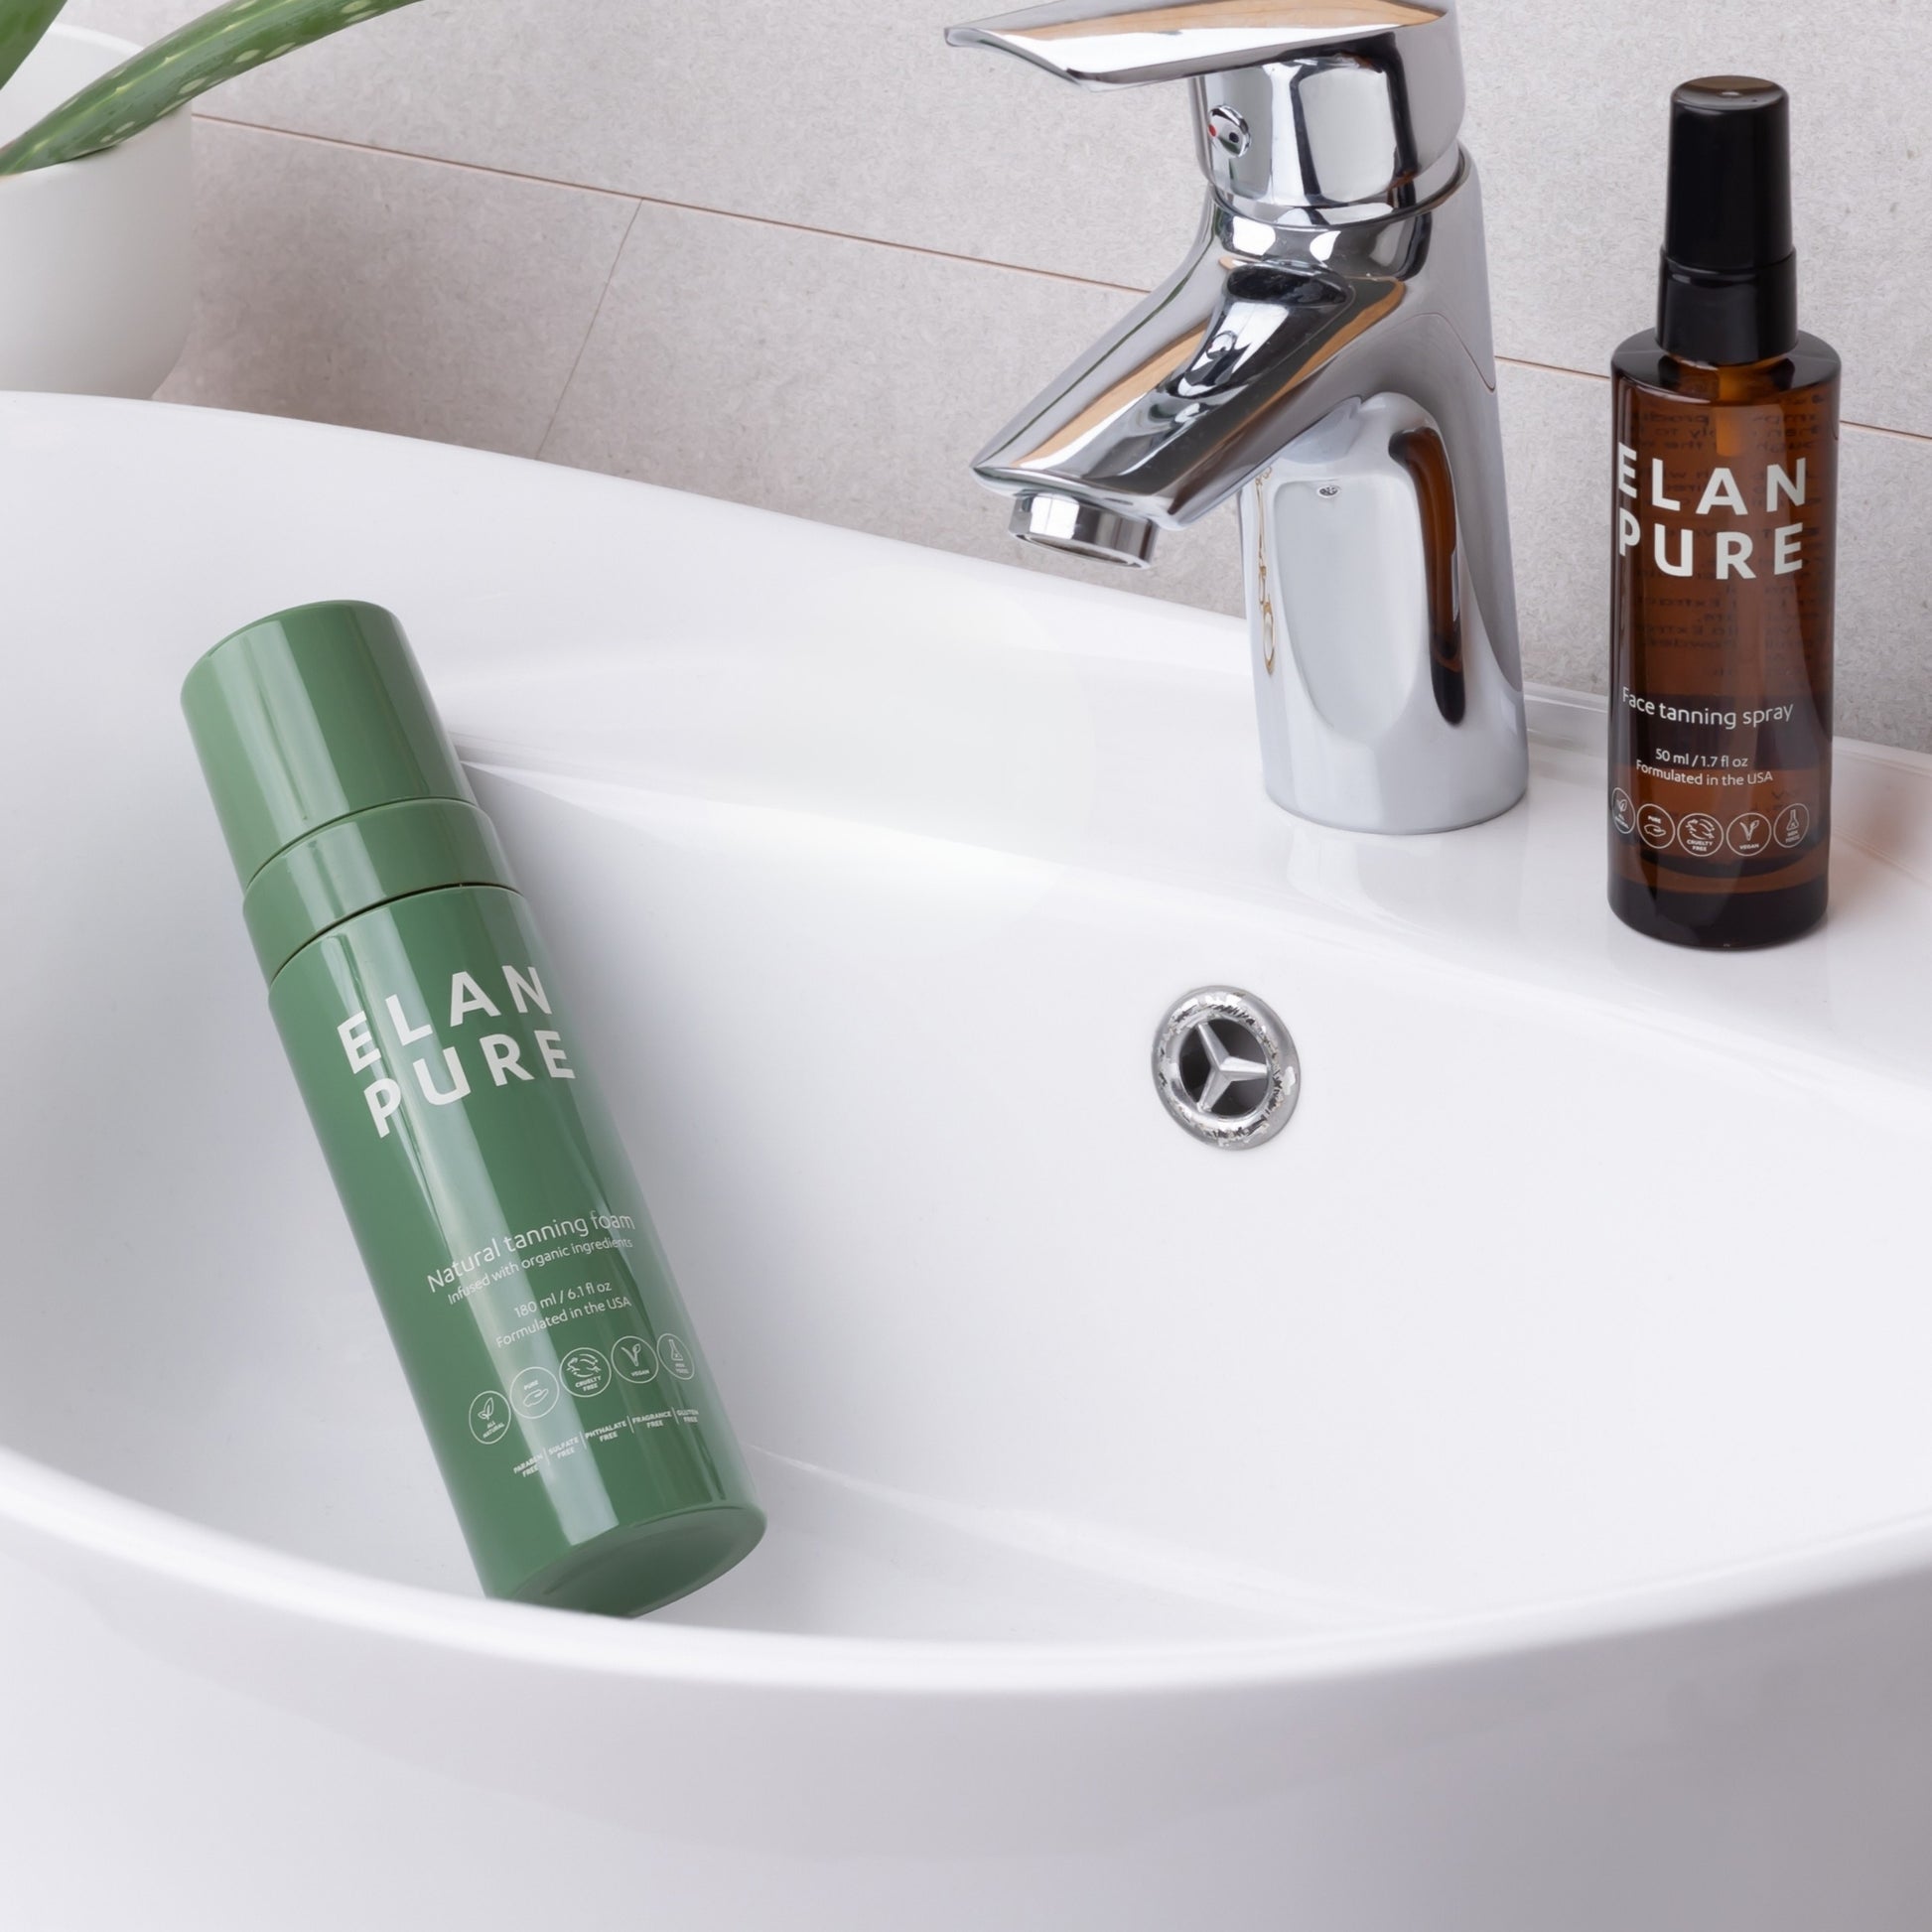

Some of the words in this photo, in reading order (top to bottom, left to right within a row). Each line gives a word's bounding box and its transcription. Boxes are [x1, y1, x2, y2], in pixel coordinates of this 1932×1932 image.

[1618, 441, 1806, 515] ELAN
[1619, 507, 1803, 580] PURE
[1622, 687, 1654, 715] Face
[1659, 703, 1736, 730] tanning
[1742, 703, 1794, 727] spray
[1636, 759, 1703, 785] Formulated
[1707, 774, 1718, 785] in
[1723, 774, 1743, 785] the
[1747, 770, 1773, 784] USA
[1656, 749, 1670, 761] 50
[1673, 753, 1689, 764] ml
[1701, 756, 1718, 767] 1.7
[1721, 756, 1728, 767] fl
[1732, 758, 1748, 767] oz
[337, 960, 552, 1074] ELAN
[363, 1030, 576, 1138] PURE
[427, 1237, 500, 1293] Natural
[503, 1219, 589, 1252] tanning
[590, 1210, 635, 1230] foam
[448, 1273, 490, 1305] Infused
[490, 1262, 518, 1282] with
[521, 1246, 571, 1269] organic
[571, 1235, 633, 1255] ingredients
[495, 1310, 568, 1348] Formulated
[569, 1306, 583, 1319] in
[584, 1300, 606, 1315] the
[606, 1296, 632, 1310] USA
[514, 1301, 537, 1317] 180
[540, 1294, 557, 1310] ml
[567, 1286, 584, 1301] 6.1
[586, 1282, 595, 1295] fl
[597, 1282, 613, 1293] oz
[631, 1411, 672, 1425] FRAGRANCE
